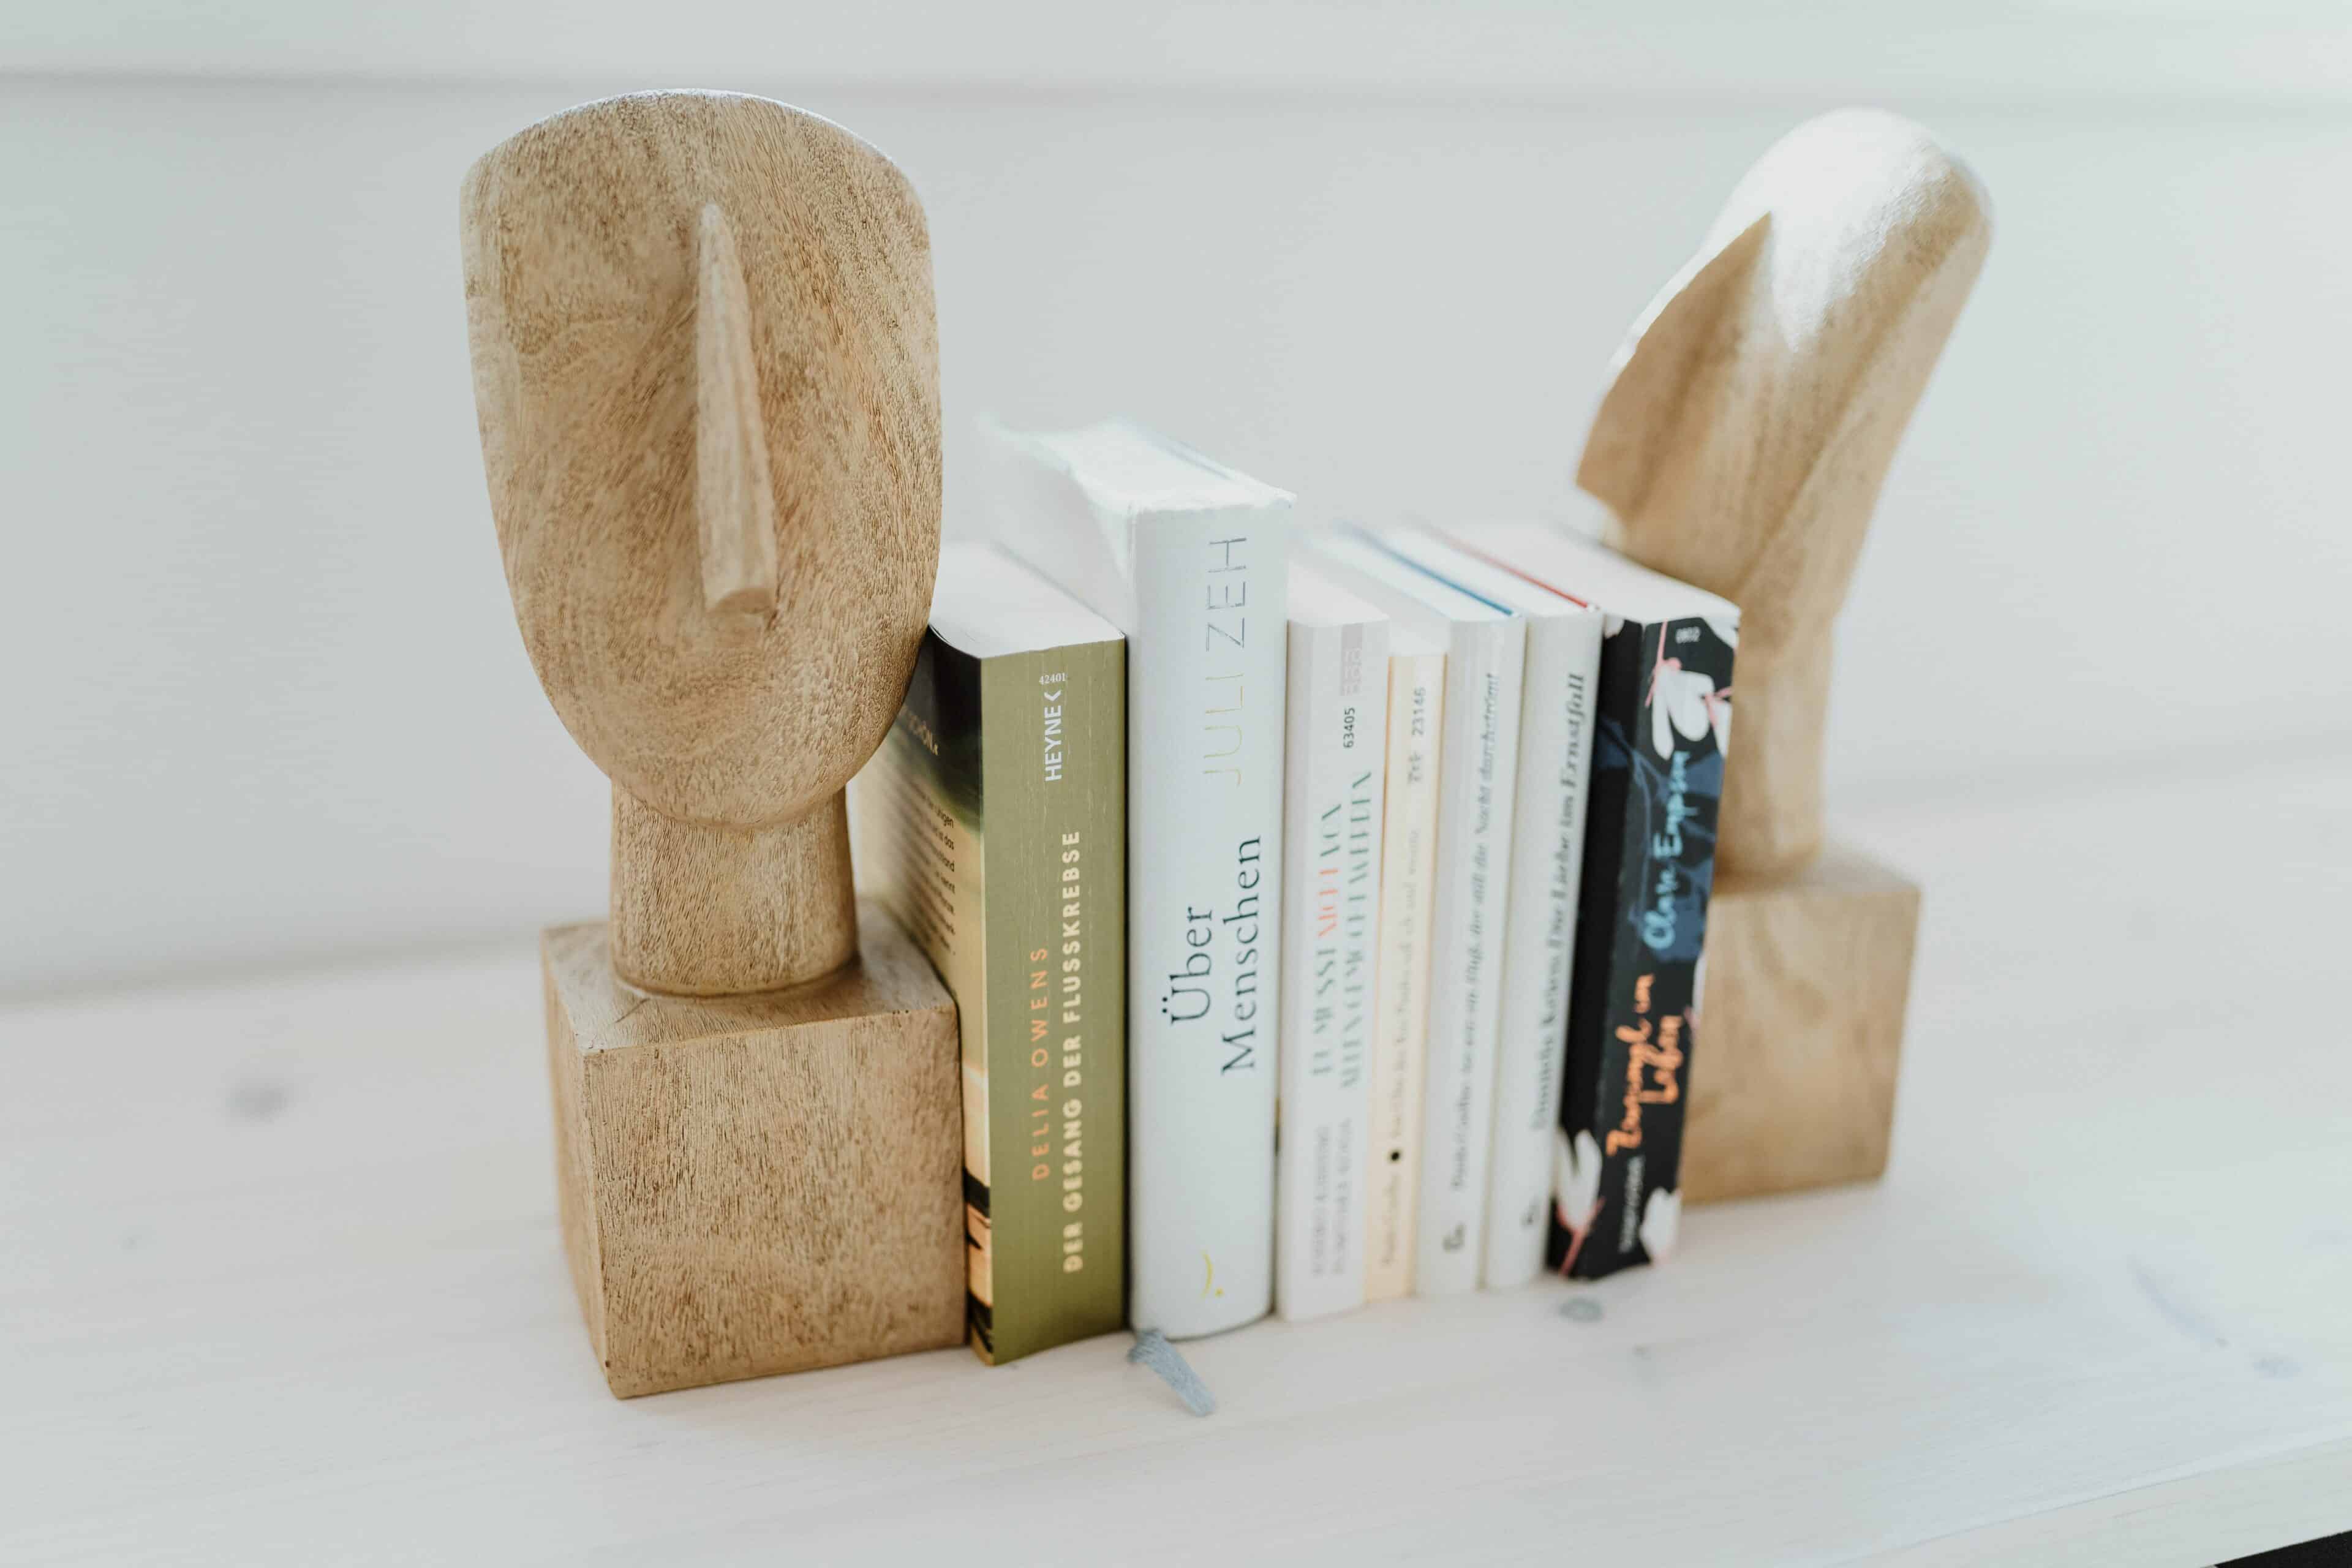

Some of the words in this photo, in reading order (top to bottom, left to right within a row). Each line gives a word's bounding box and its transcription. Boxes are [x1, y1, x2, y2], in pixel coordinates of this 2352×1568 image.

[1205, 537, 1247, 652] ZEH
[1039, 673, 1066, 685] 42401
[1203, 673, 1244, 787] JULI
[1343, 706, 1355, 748] 63405
[1559, 671, 1586, 789] Ernstfall
[1044, 705, 1063, 782] HEYNE
[1062, 831, 1081, 1023] FLUSSKREBSE
[1162, 907, 1212, 1025] Über
[1222, 835, 1261, 1076] Menschen
[1030, 948, 1049, 1066] OWENS
[1063, 1035, 1082, 1088] DER
[1033, 1084, 1050, 1180] DELIA
[1063, 1098, 1082, 1212] GESANG
[1063, 1222, 1083, 1273] DER
